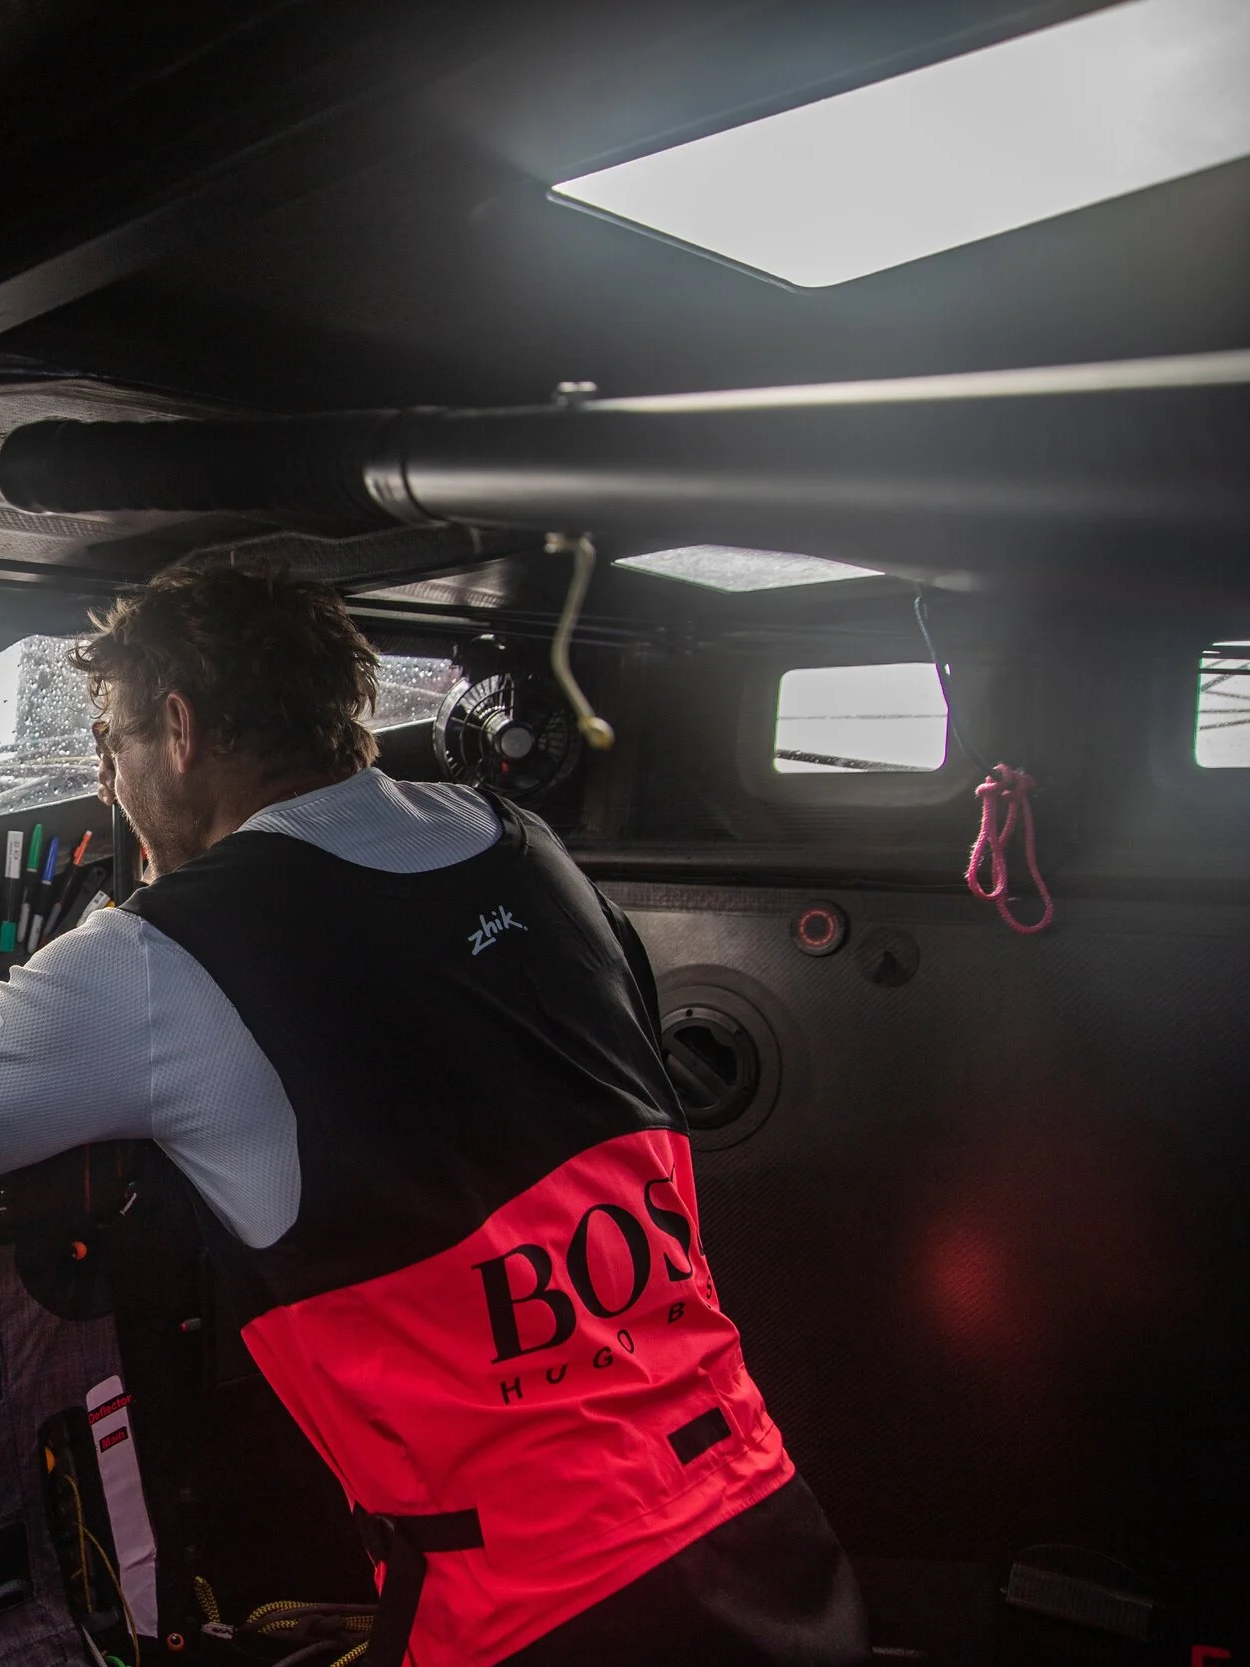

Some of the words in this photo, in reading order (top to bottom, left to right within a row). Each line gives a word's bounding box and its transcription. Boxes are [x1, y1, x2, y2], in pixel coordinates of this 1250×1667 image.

[471, 1165, 705, 1365] BOS
[501, 1329, 635, 1405] HUGO
[88, 1394, 133, 1424] Deflector
[101, 1429, 125, 1451] Main
